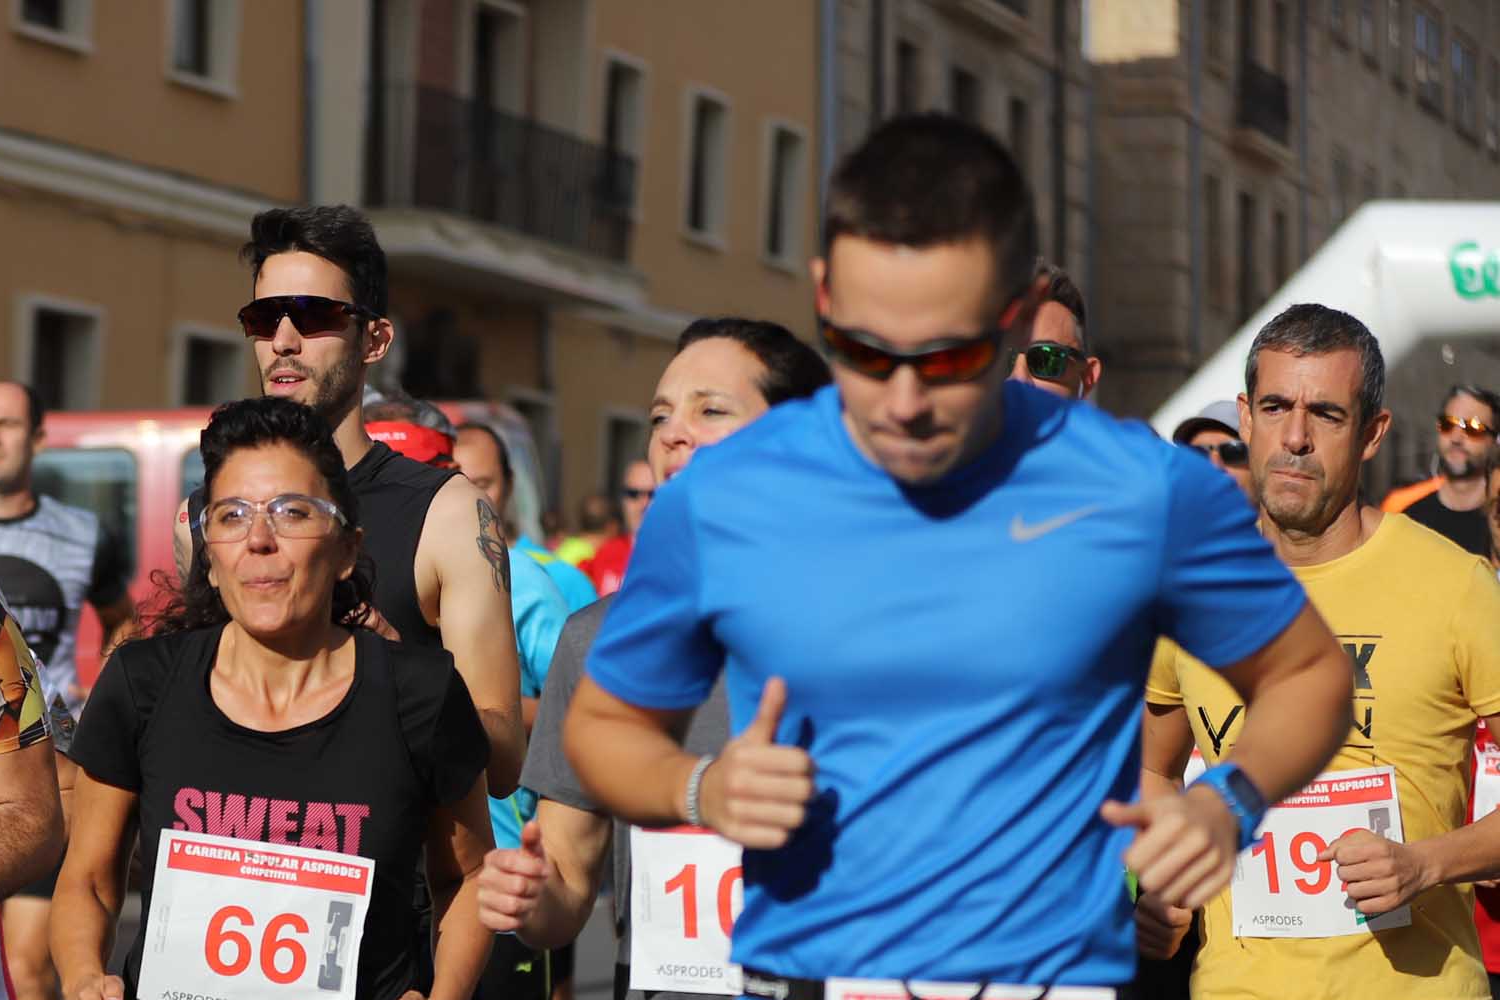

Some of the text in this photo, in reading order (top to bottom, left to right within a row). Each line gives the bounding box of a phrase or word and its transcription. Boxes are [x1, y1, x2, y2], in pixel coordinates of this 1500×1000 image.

[1331, 777, 1385, 792] ASPRODES
[173, 786, 370, 856] SWEAT
[173, 842, 362, 880] V CARRERA POPULAR ASPRODES
[240, 865, 298, 882] COMPETITIVA
[1252, 827, 1368, 895] 19
[1252, 914, 1303, 926] ASPRODES
[204, 905, 310, 985] 66
[657, 963, 724, 978] ASPRODES
